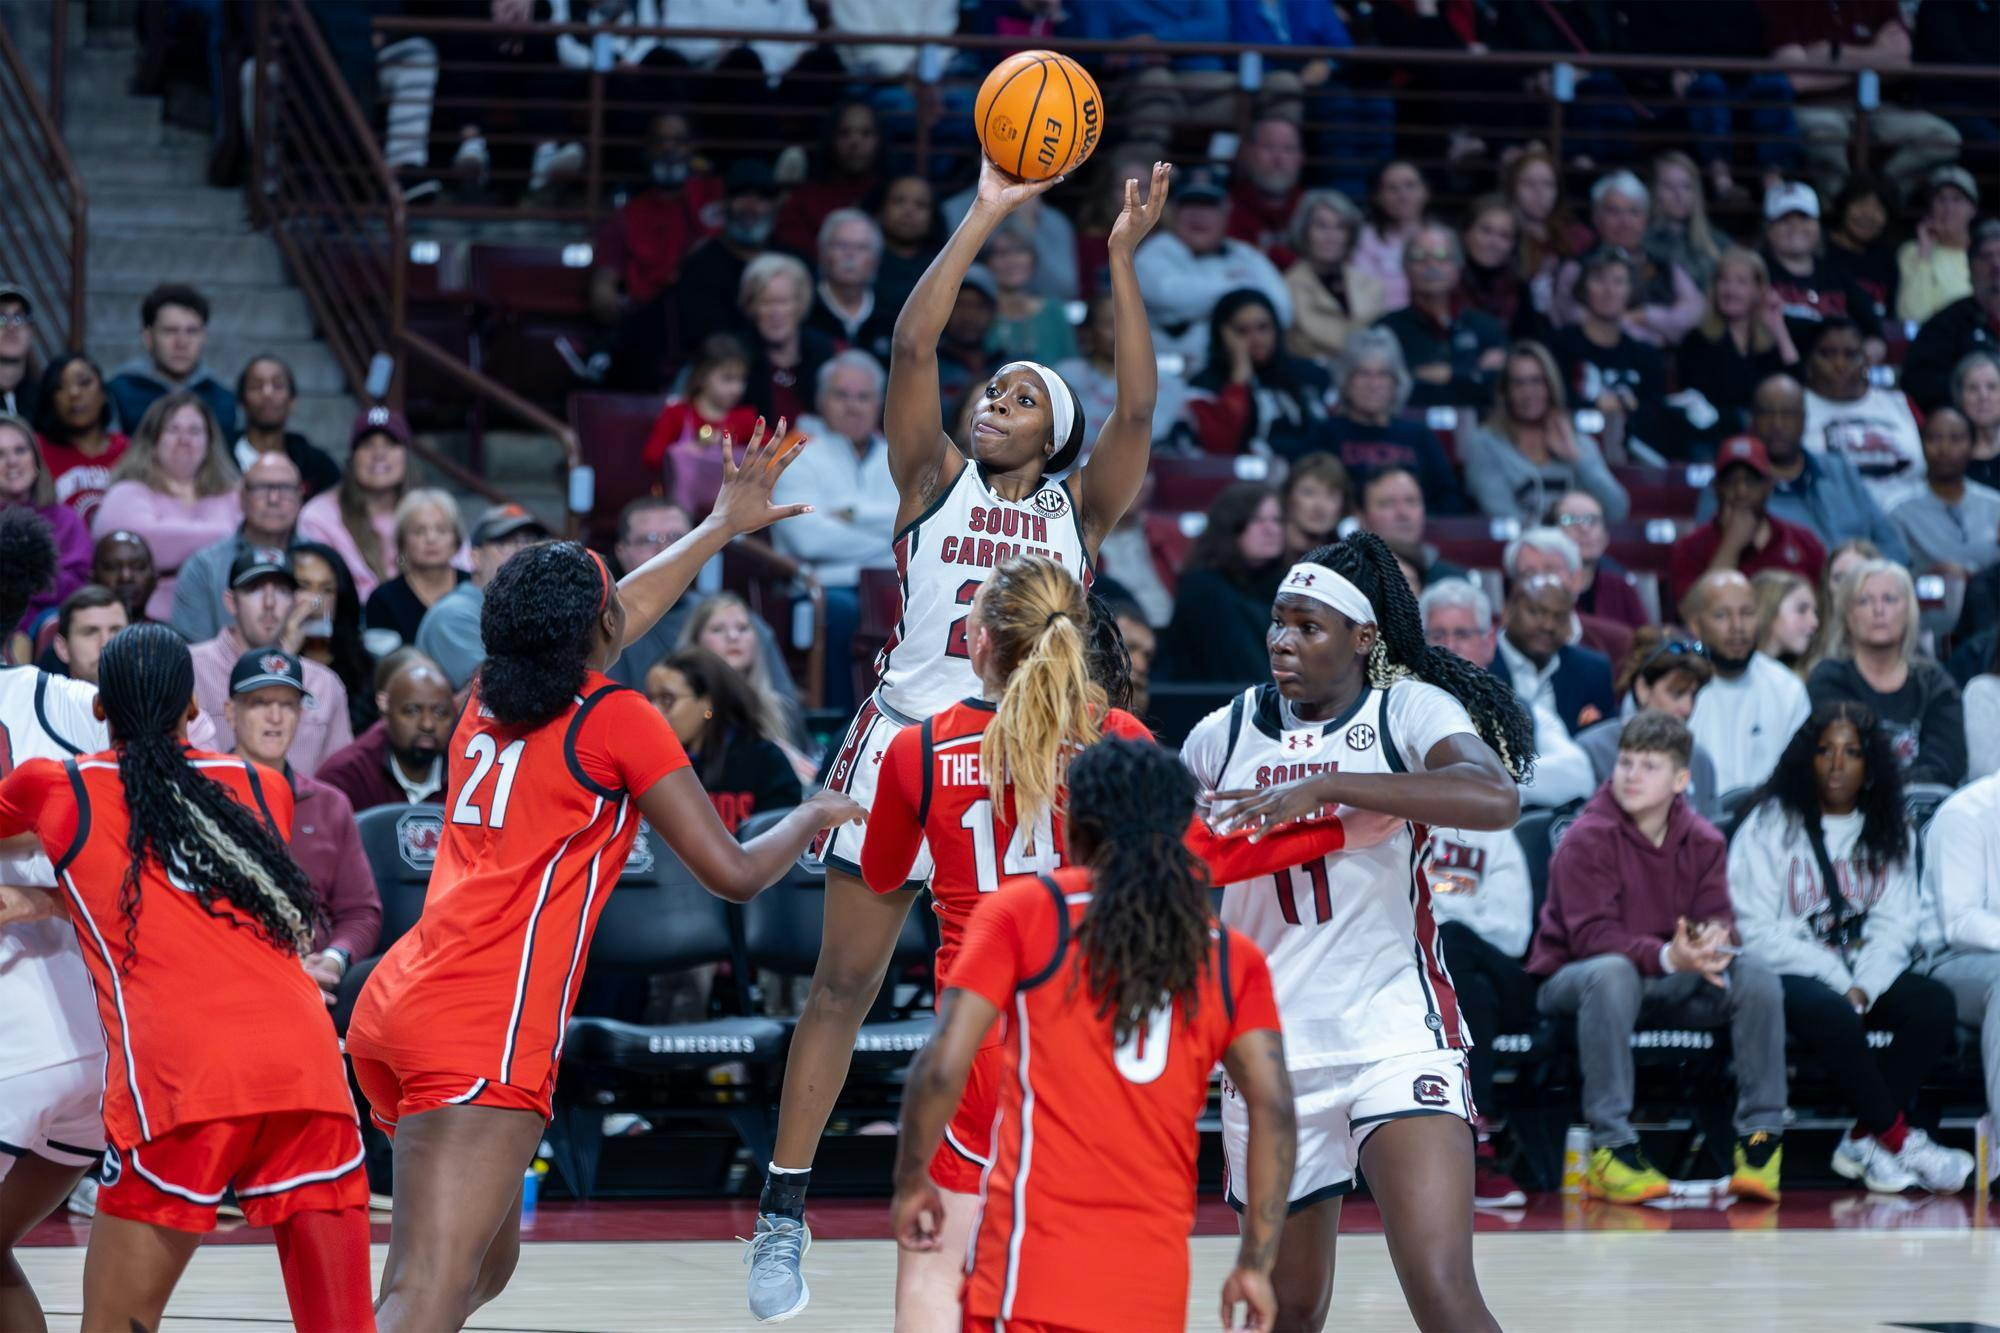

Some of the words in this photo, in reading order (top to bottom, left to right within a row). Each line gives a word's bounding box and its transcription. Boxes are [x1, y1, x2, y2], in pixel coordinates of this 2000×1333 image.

[1036, 490, 1063, 511] SEC
[968, 506, 1047, 543] SOUTH
[1346, 724, 1374, 750] SEC
[451, 731, 527, 829] 21
[960, 797, 1062, 893] 14
